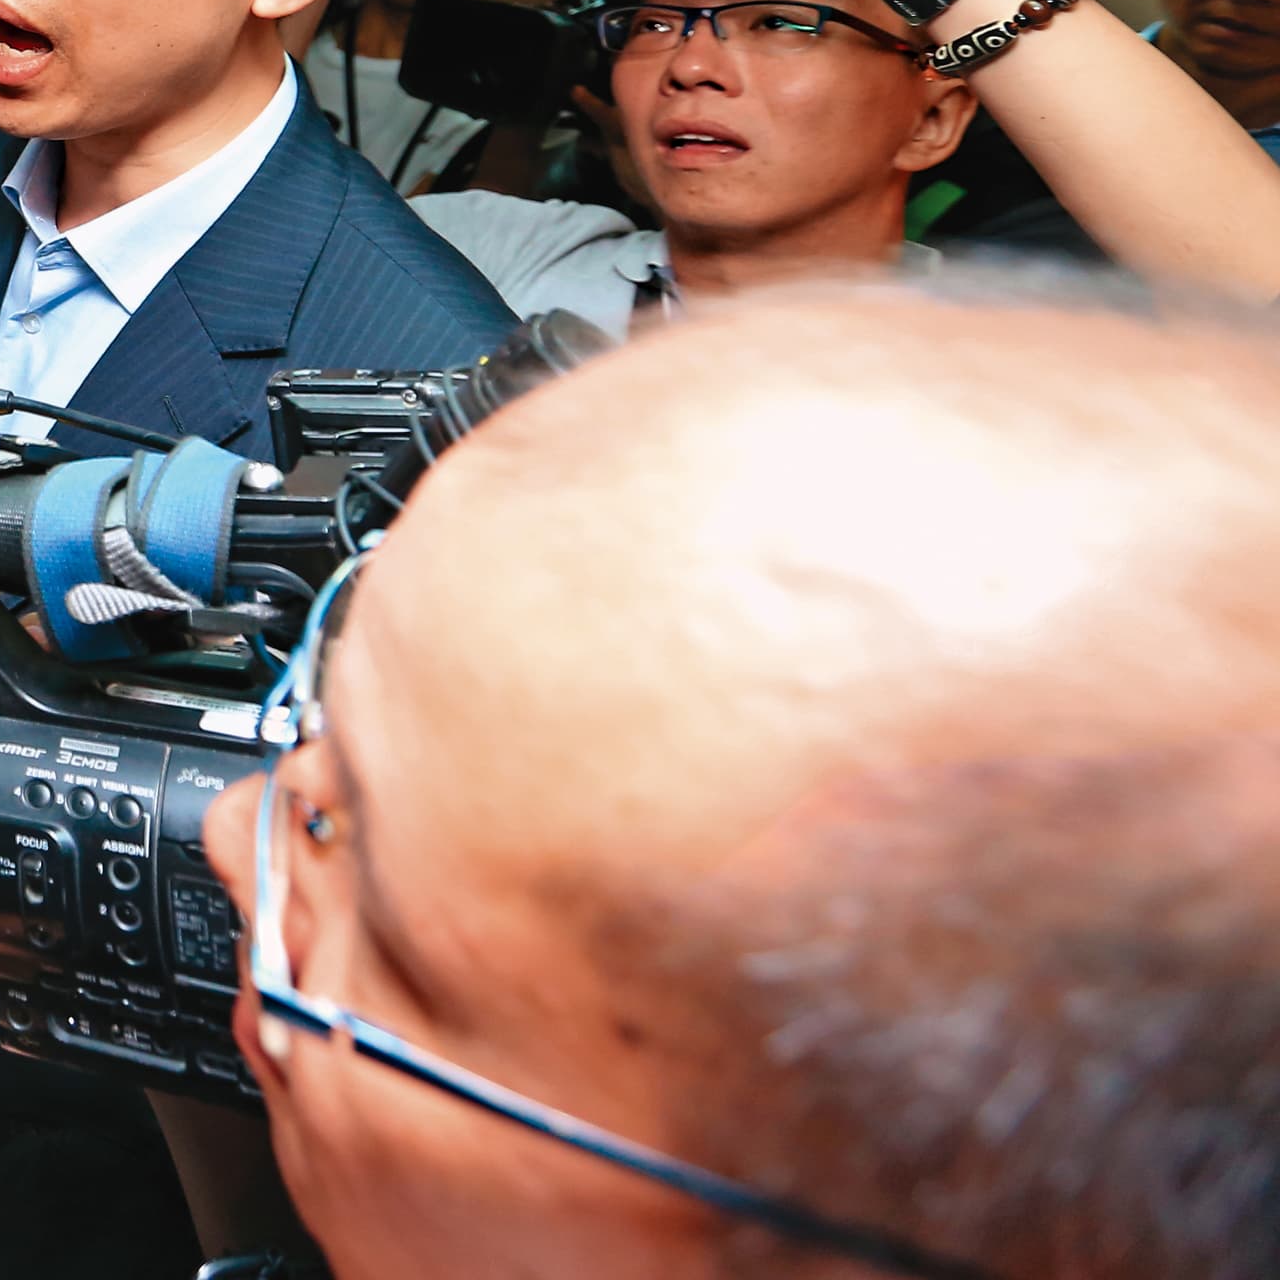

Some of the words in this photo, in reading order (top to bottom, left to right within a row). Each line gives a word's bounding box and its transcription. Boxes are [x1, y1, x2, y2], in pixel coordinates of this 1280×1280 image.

[25, 767, 57, 781] ZEBRA
[102, 781, 129, 793] VISUAL
[194, 774, 225, 791] GPS
[13, 786, 22, 796] 4
[16, 835, 49, 852] FOCUS
[102, 839, 145, 857] ASSIGN
